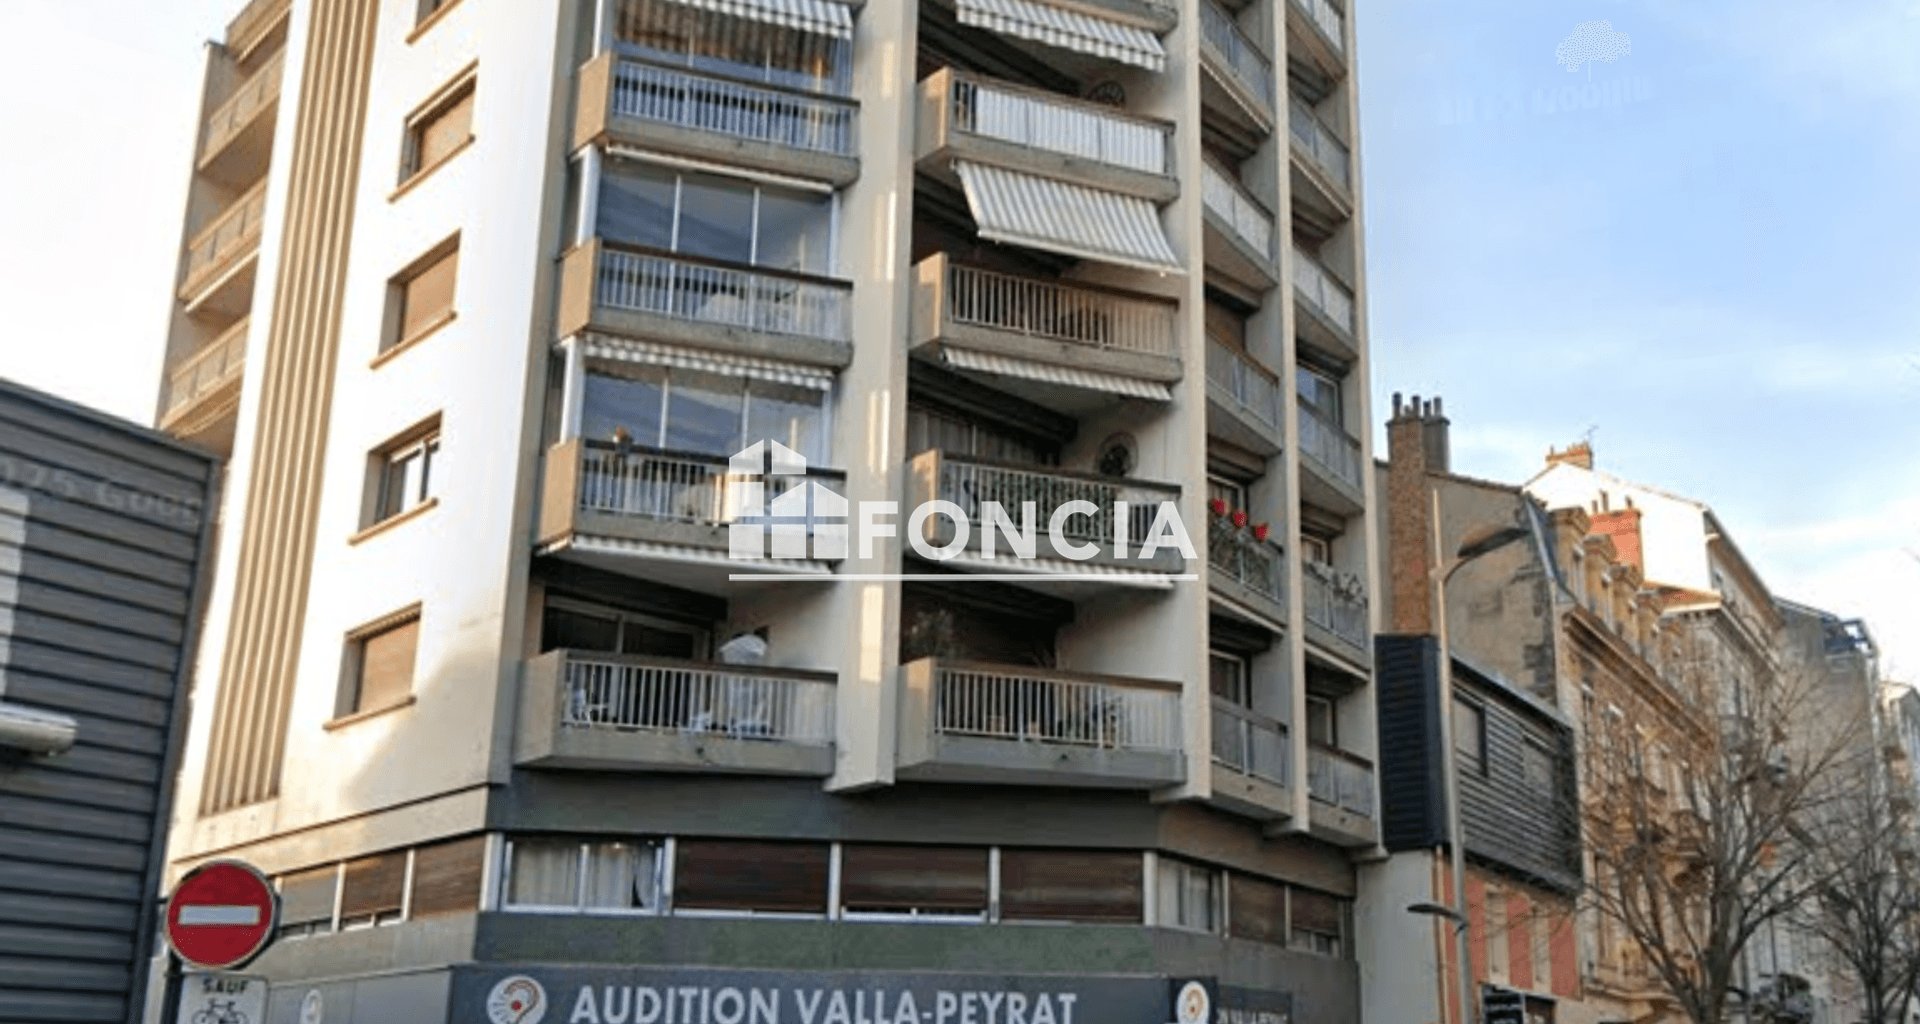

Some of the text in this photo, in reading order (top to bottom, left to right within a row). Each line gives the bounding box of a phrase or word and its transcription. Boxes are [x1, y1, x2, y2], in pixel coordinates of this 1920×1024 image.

[202, 978, 248, 994] SAUF
[570, 985, 1077, 1024] AUDITION VALLA-PEYRAT
